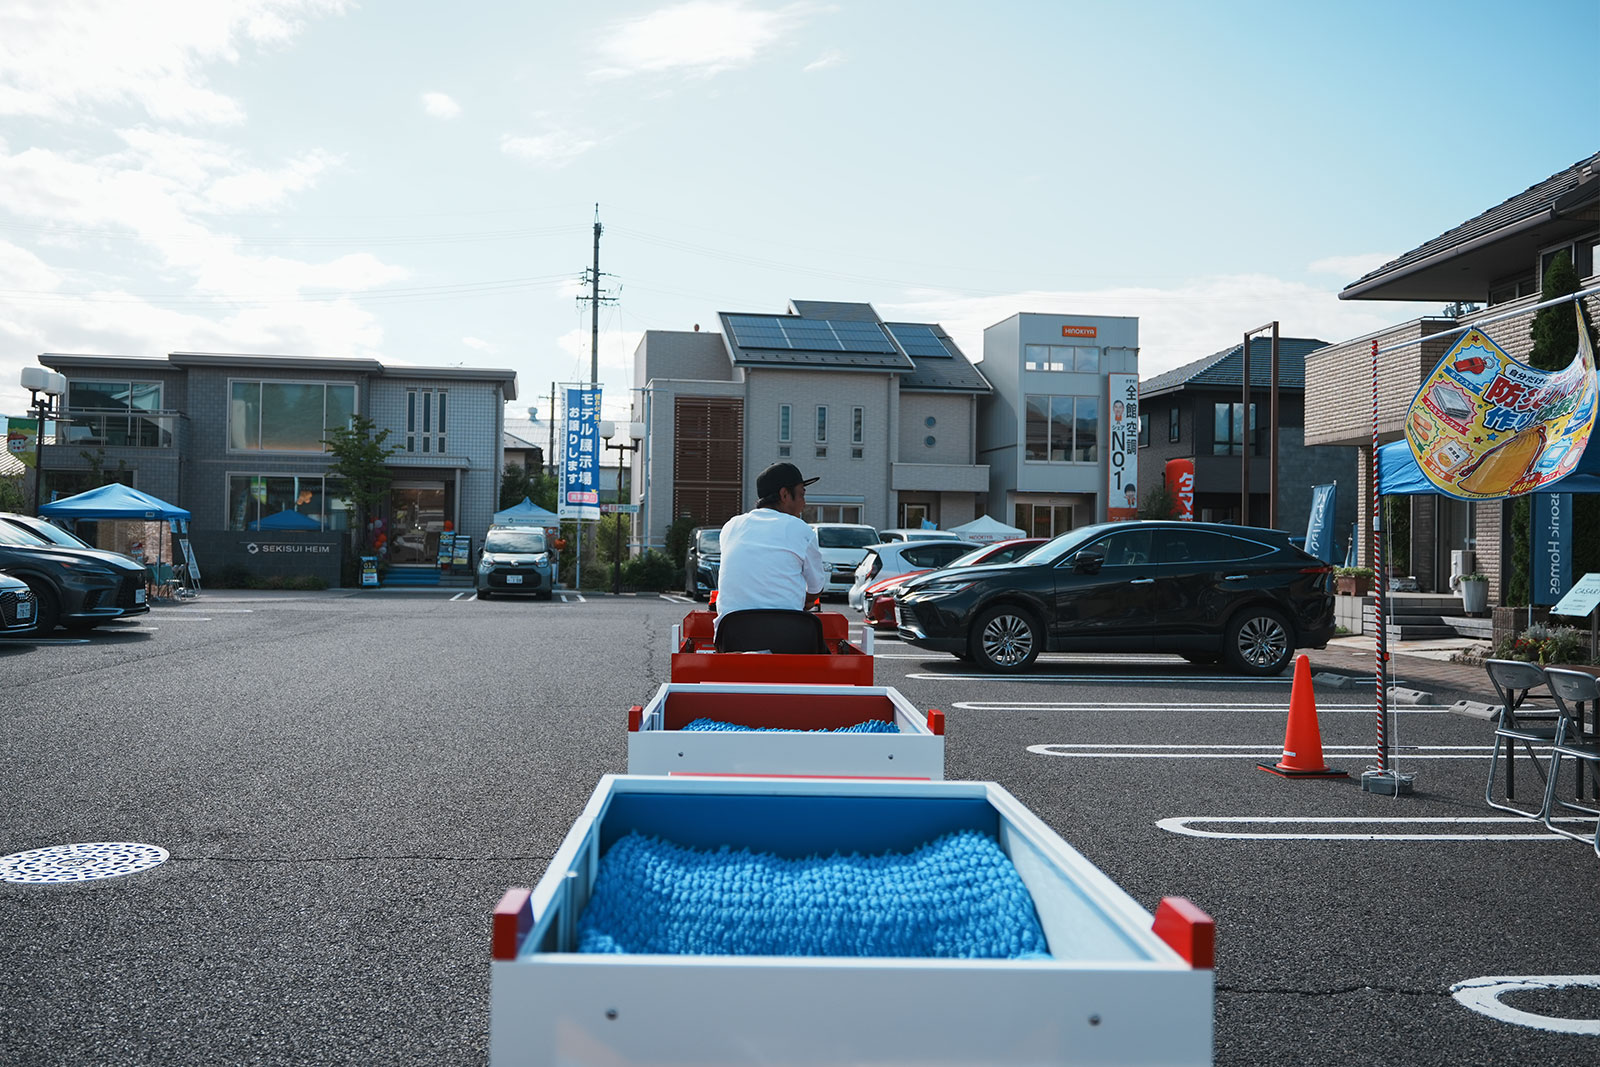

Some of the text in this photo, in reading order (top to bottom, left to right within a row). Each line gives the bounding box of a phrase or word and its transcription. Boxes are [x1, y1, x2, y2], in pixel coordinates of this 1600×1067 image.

[1450, 371, 1475, 390] ホイッスル
[1126, 385, 1137, 456] 全館空調
[1424, 399, 1465, 432] アルミブランケット
[567, 407, 580, 485] お譲りします
[578, 393, 594, 485] モデル展示場
[262, 545, 330, 553] SEKISUI HEIM
[1575, 587, 1600, 595] CASAR
